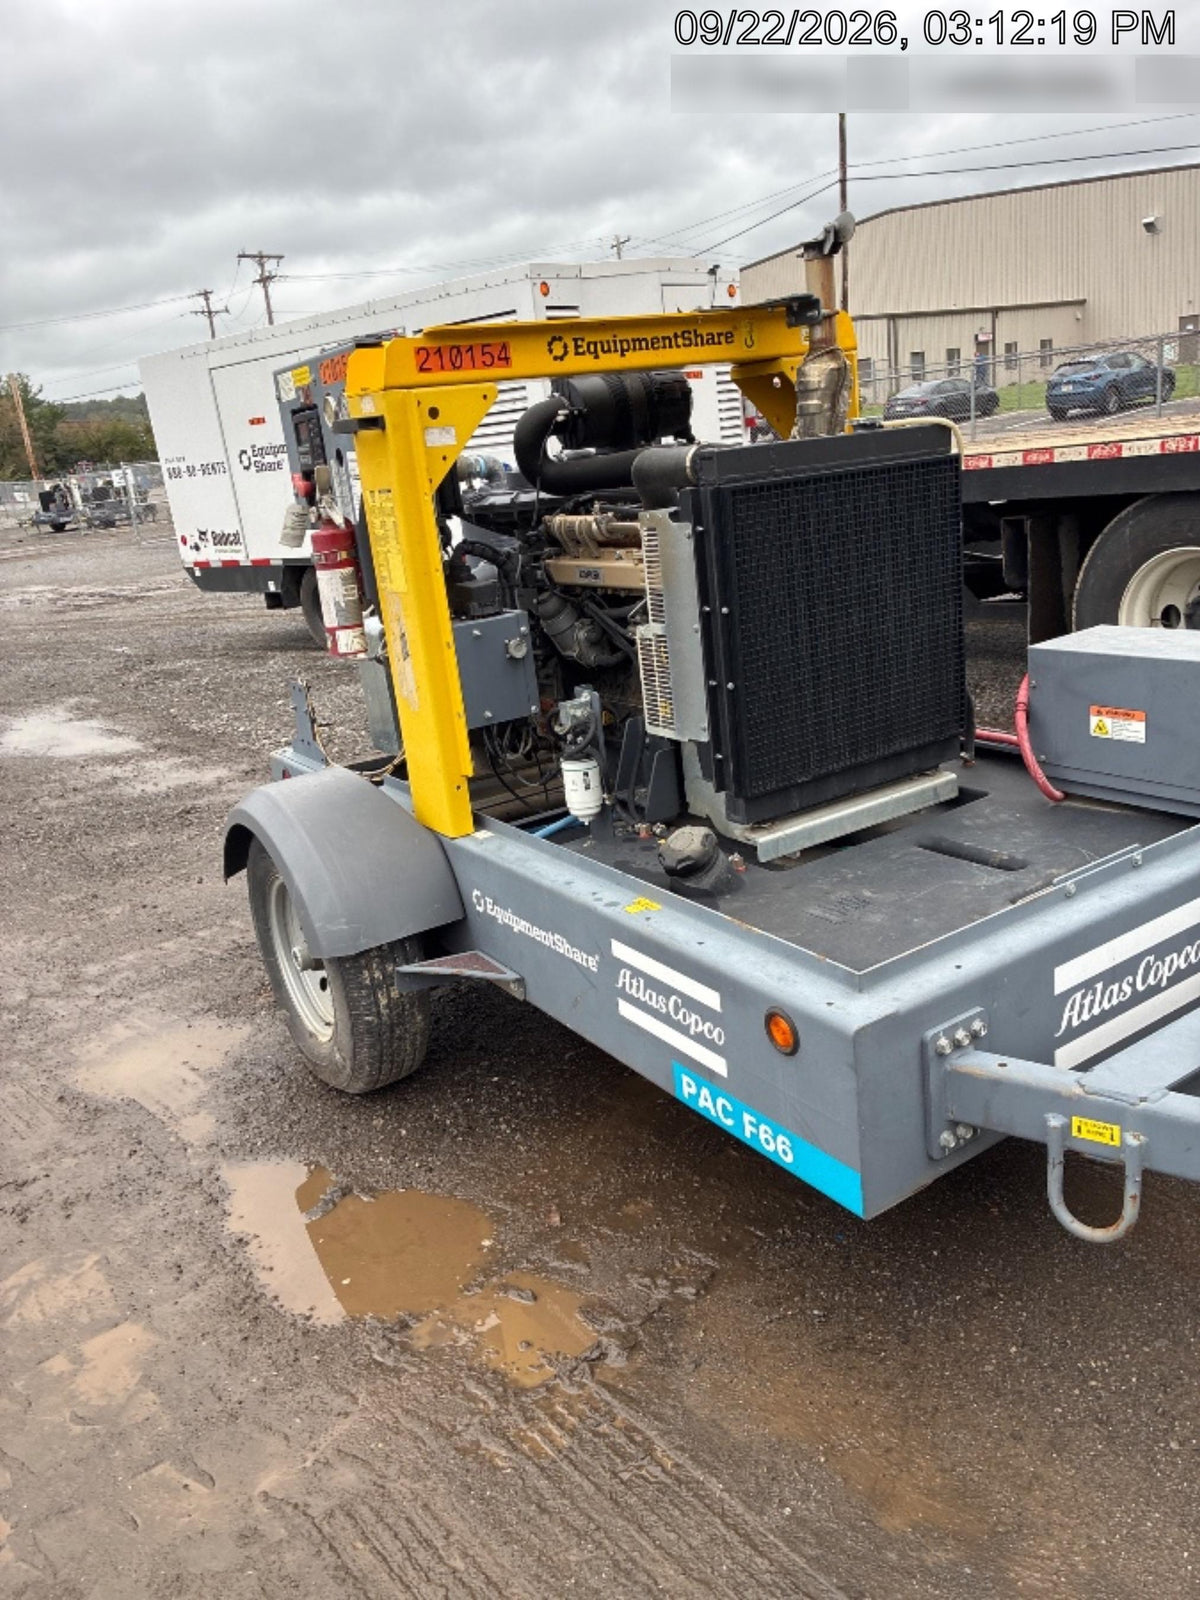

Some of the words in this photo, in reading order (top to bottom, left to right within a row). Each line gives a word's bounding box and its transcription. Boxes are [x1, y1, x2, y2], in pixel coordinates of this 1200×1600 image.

[417, 342, 511, 372] 210154
[572, 328, 735, 358] EquipmentShare
[486, 896, 599, 973] EquipmentShare
[615, 967, 668, 1013] Atlas
[668, 995, 725, 1046] Copco
[1054, 975, 1133, 1038] Atlas
[681, 1073, 734, 1126] PAC
[743, 1113, 794, 1163] F66
